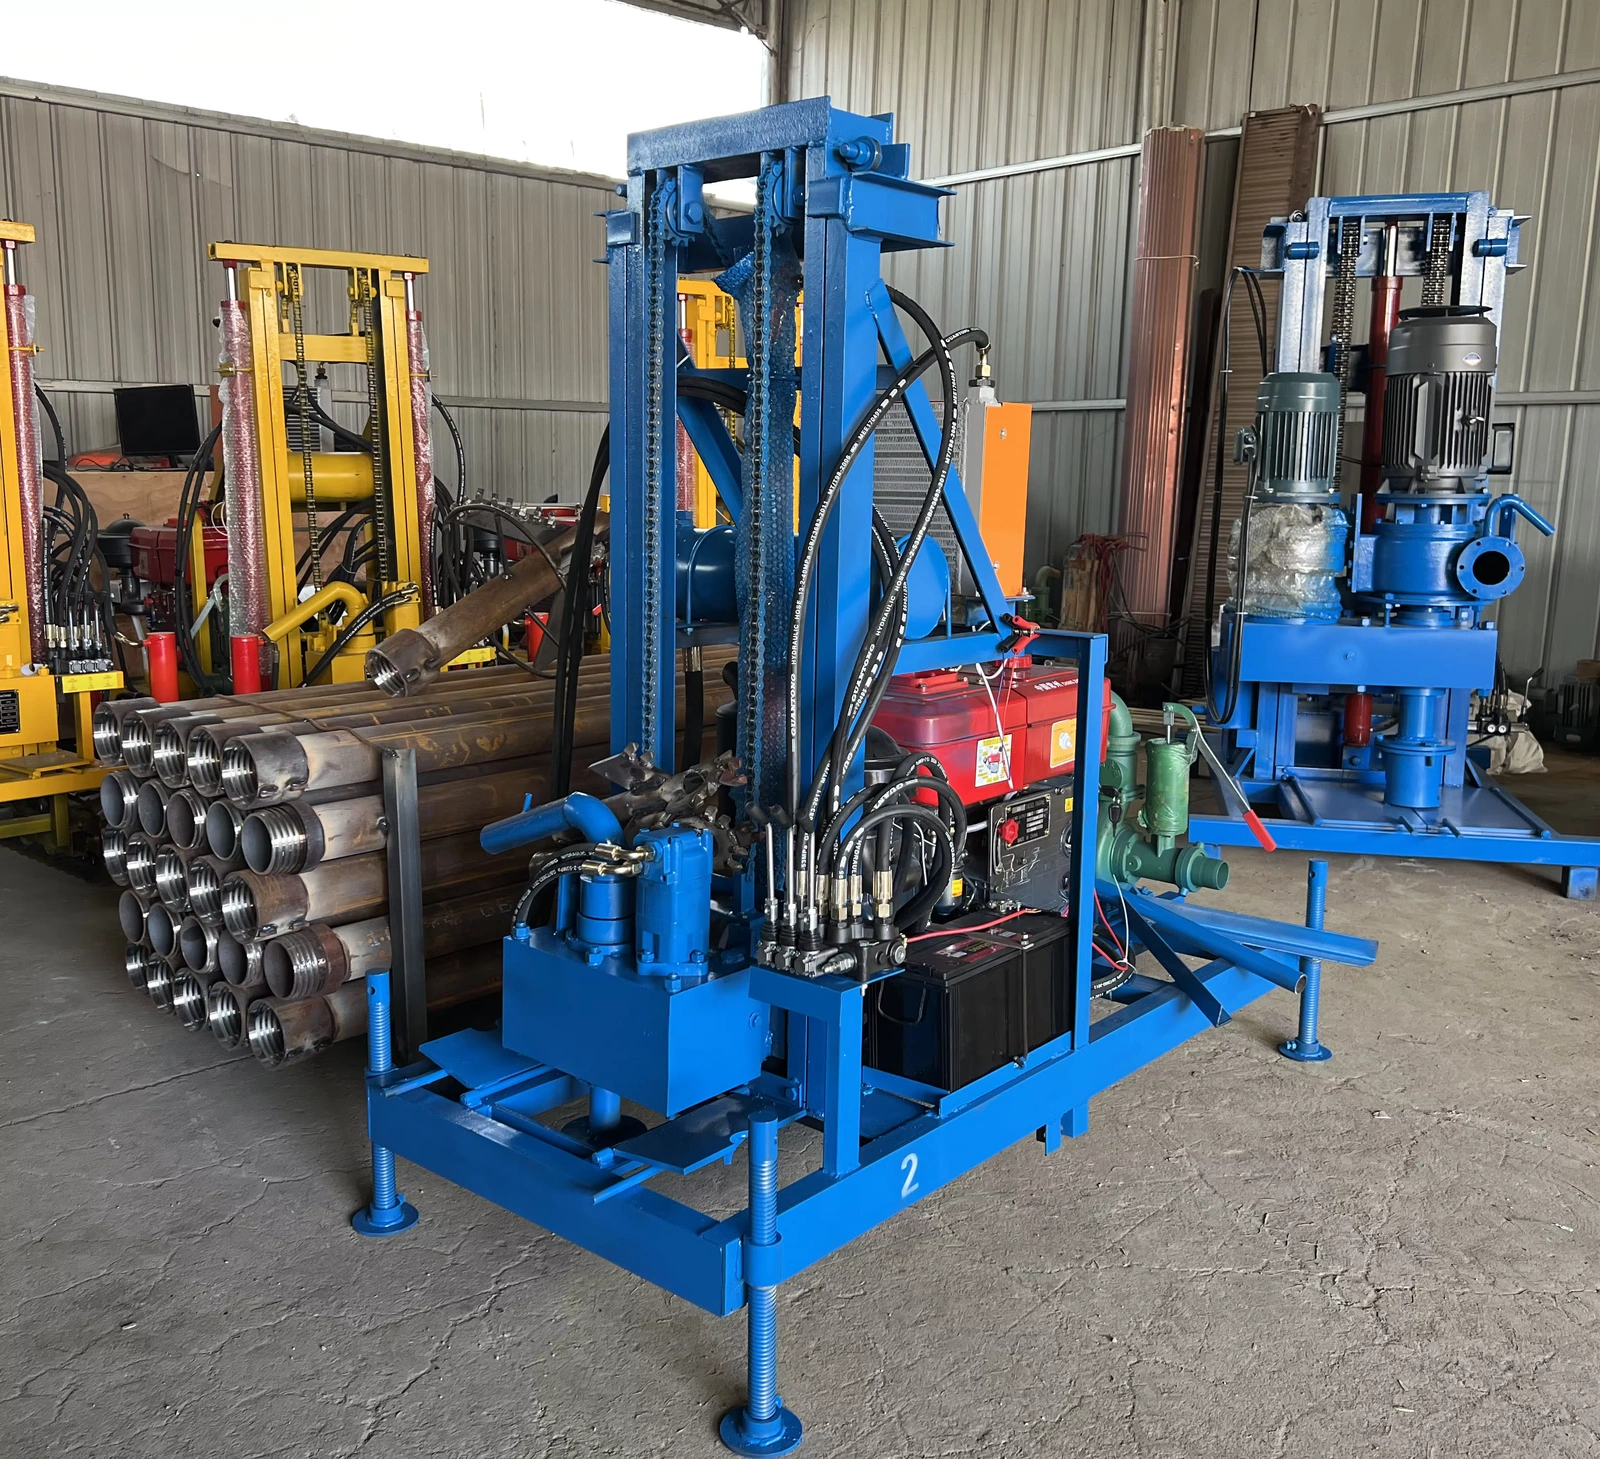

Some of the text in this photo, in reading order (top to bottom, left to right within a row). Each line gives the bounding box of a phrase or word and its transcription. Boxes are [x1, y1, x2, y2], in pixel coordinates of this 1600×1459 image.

[827, 454, 851, 495] MT/T98-2006
[807, 500, 829, 551] GB/T3683-2011
[798, 555, 812, 595] 13-2-40MPa
[851, 644, 875, 703] GUANTONG
[875, 595, 896, 636] HYDRAULIC
[894, 571, 907, 592] HOSE
[904, 526, 927, 566] 10-2-53MPa
[924, 470, 947, 522] GB/T3683-2011
[794, 600, 803, 620] HOSE
[791, 624, 800, 665] HYDRAULIC
[852, 687, 869, 719] EE170495
[900, 1152, 920, 1199] 2
